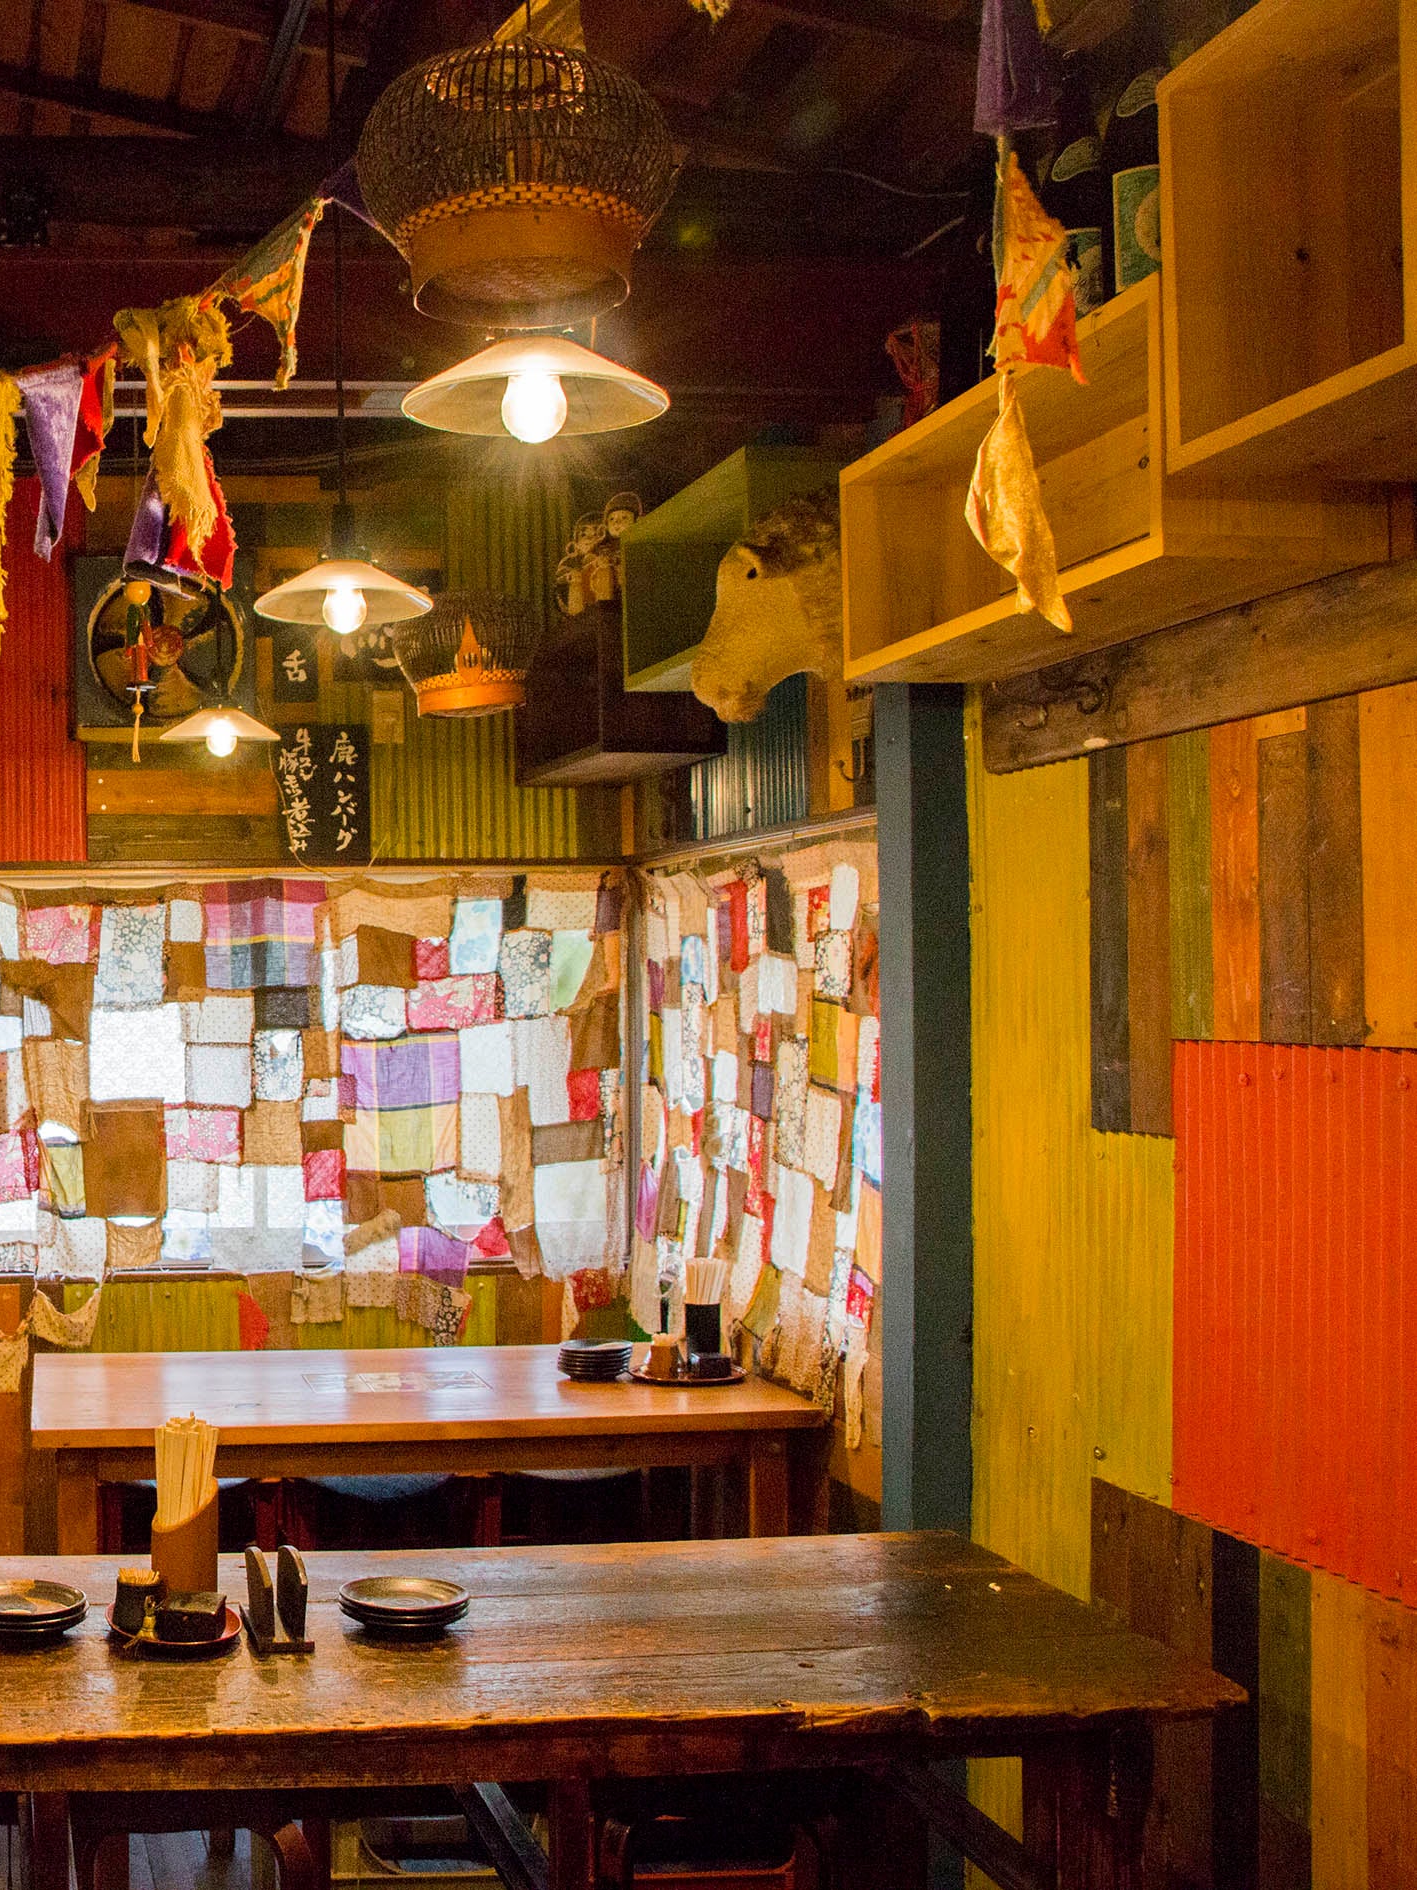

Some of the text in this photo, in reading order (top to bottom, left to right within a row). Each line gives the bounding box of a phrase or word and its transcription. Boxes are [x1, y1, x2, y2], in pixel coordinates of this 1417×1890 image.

[329, 730, 359, 852] 鹿ハンバーグ
